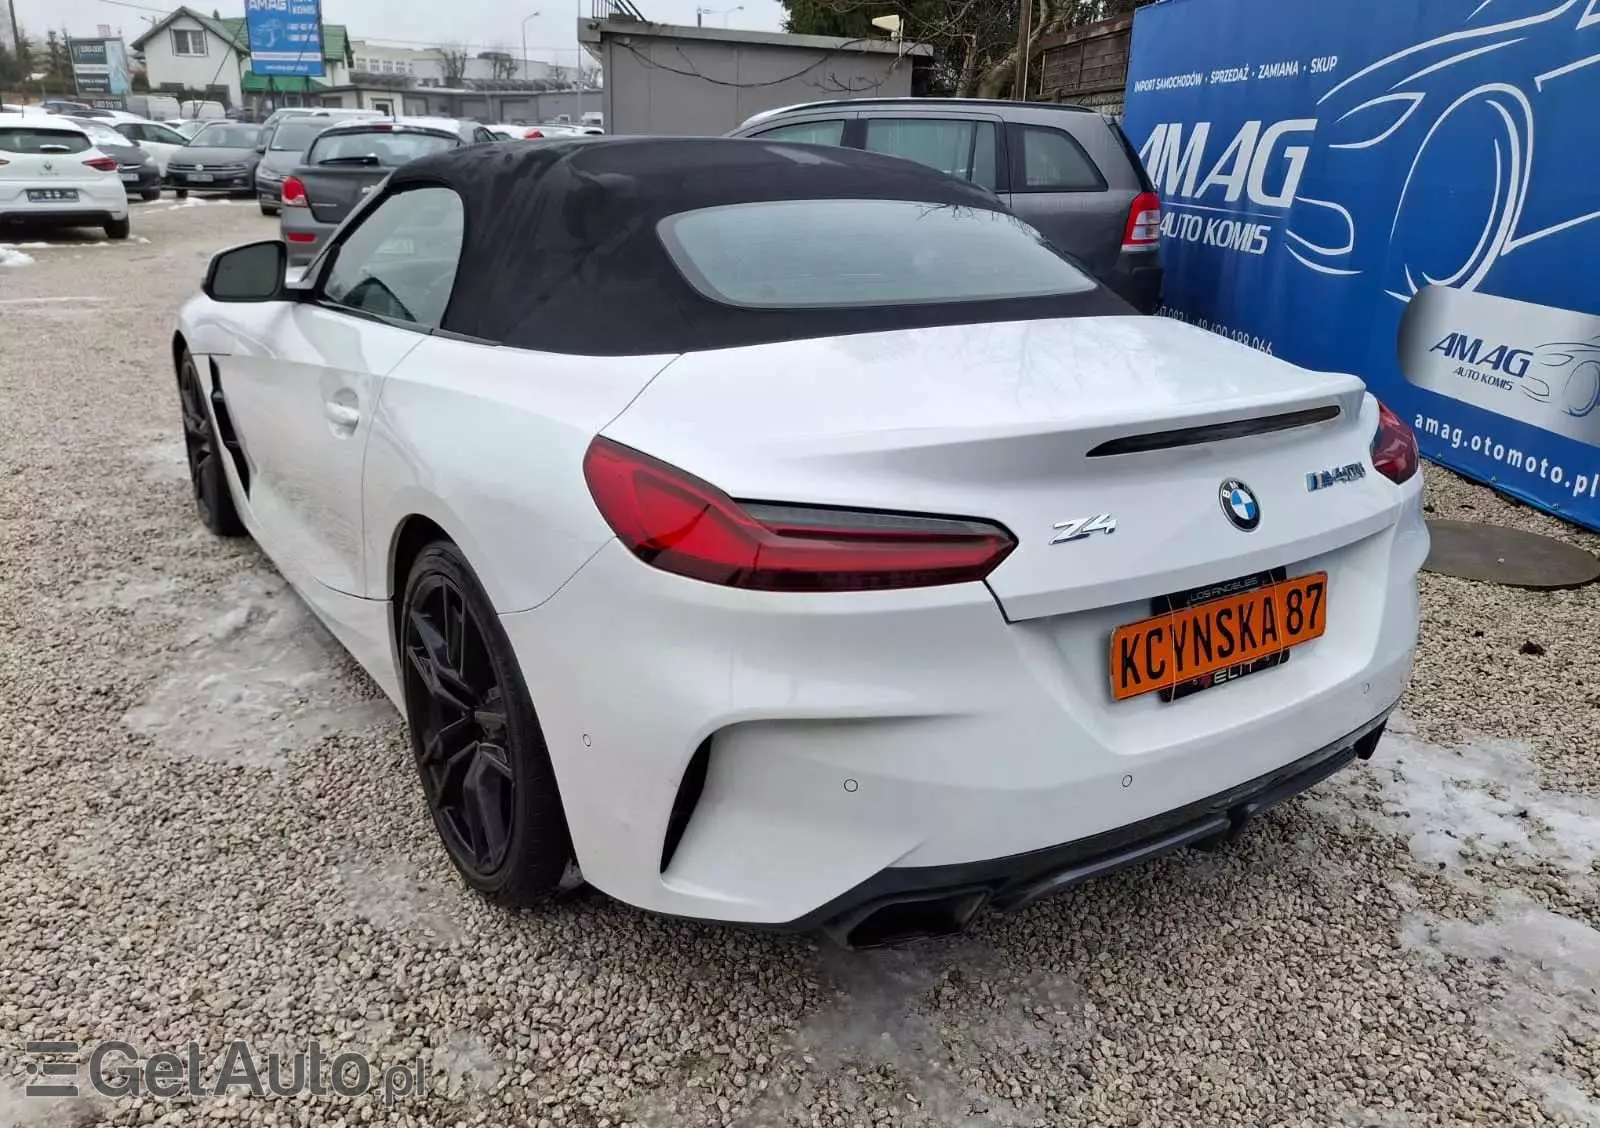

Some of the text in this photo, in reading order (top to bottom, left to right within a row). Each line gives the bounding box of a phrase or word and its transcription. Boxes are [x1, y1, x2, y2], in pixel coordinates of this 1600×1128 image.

[1210, 64, 1250, 84] SPRZEDAŻ
[1258, 61, 1299, 79] ZAMIANA
[1310, 56, 1338, 73] SKUP
[1159, 211, 1272, 255] AUTO KOMIS
[1429, 331, 1534, 378] AMAG
[1454, 366, 1515, 391] AUTO KOMIS
[1415, 413, 1600, 498] amag.otomoto.pl
[1049, 512, 1118, 545] Z4
[1120, 582, 1324, 689] KCYNSKA 87
